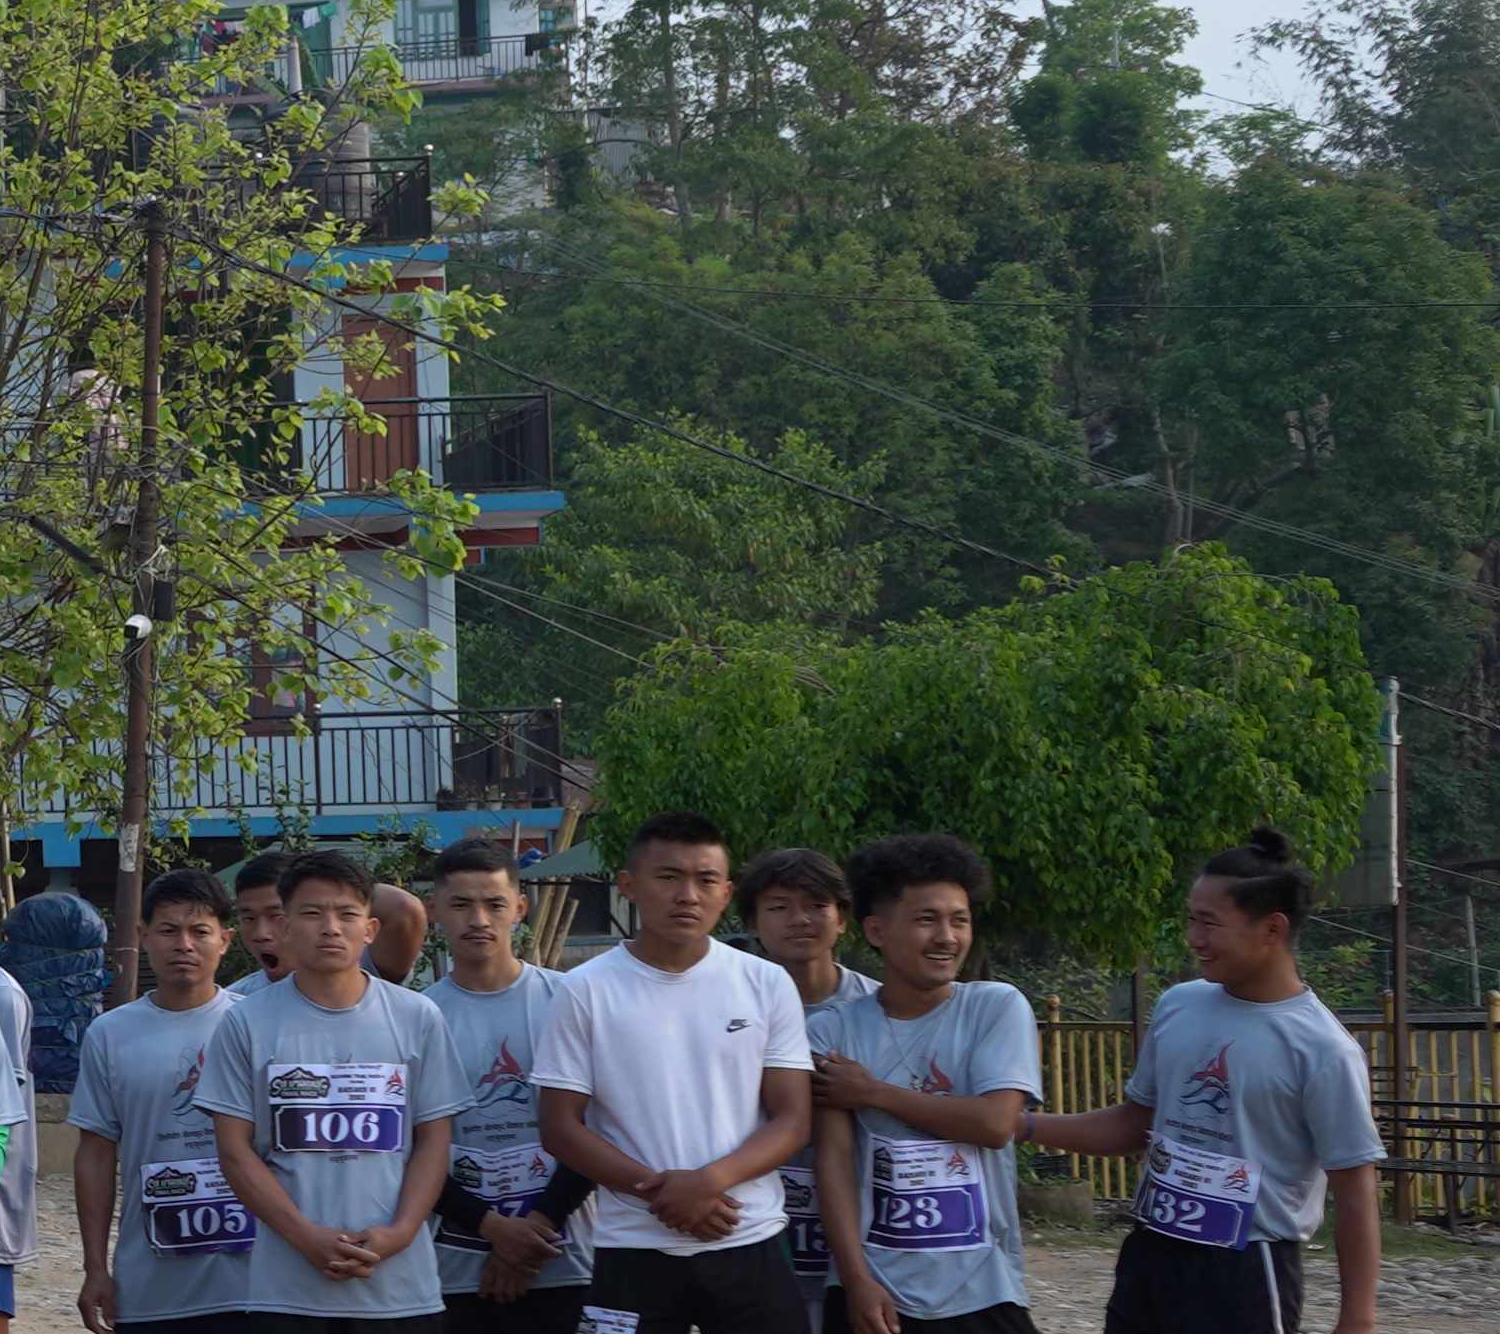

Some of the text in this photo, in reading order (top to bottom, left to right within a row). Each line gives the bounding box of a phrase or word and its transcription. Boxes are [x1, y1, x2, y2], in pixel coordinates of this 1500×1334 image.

[303, 1111, 380, 1143] 106
[177, 1204, 247, 1237] 105
[879, 1196, 942, 1228] 123
